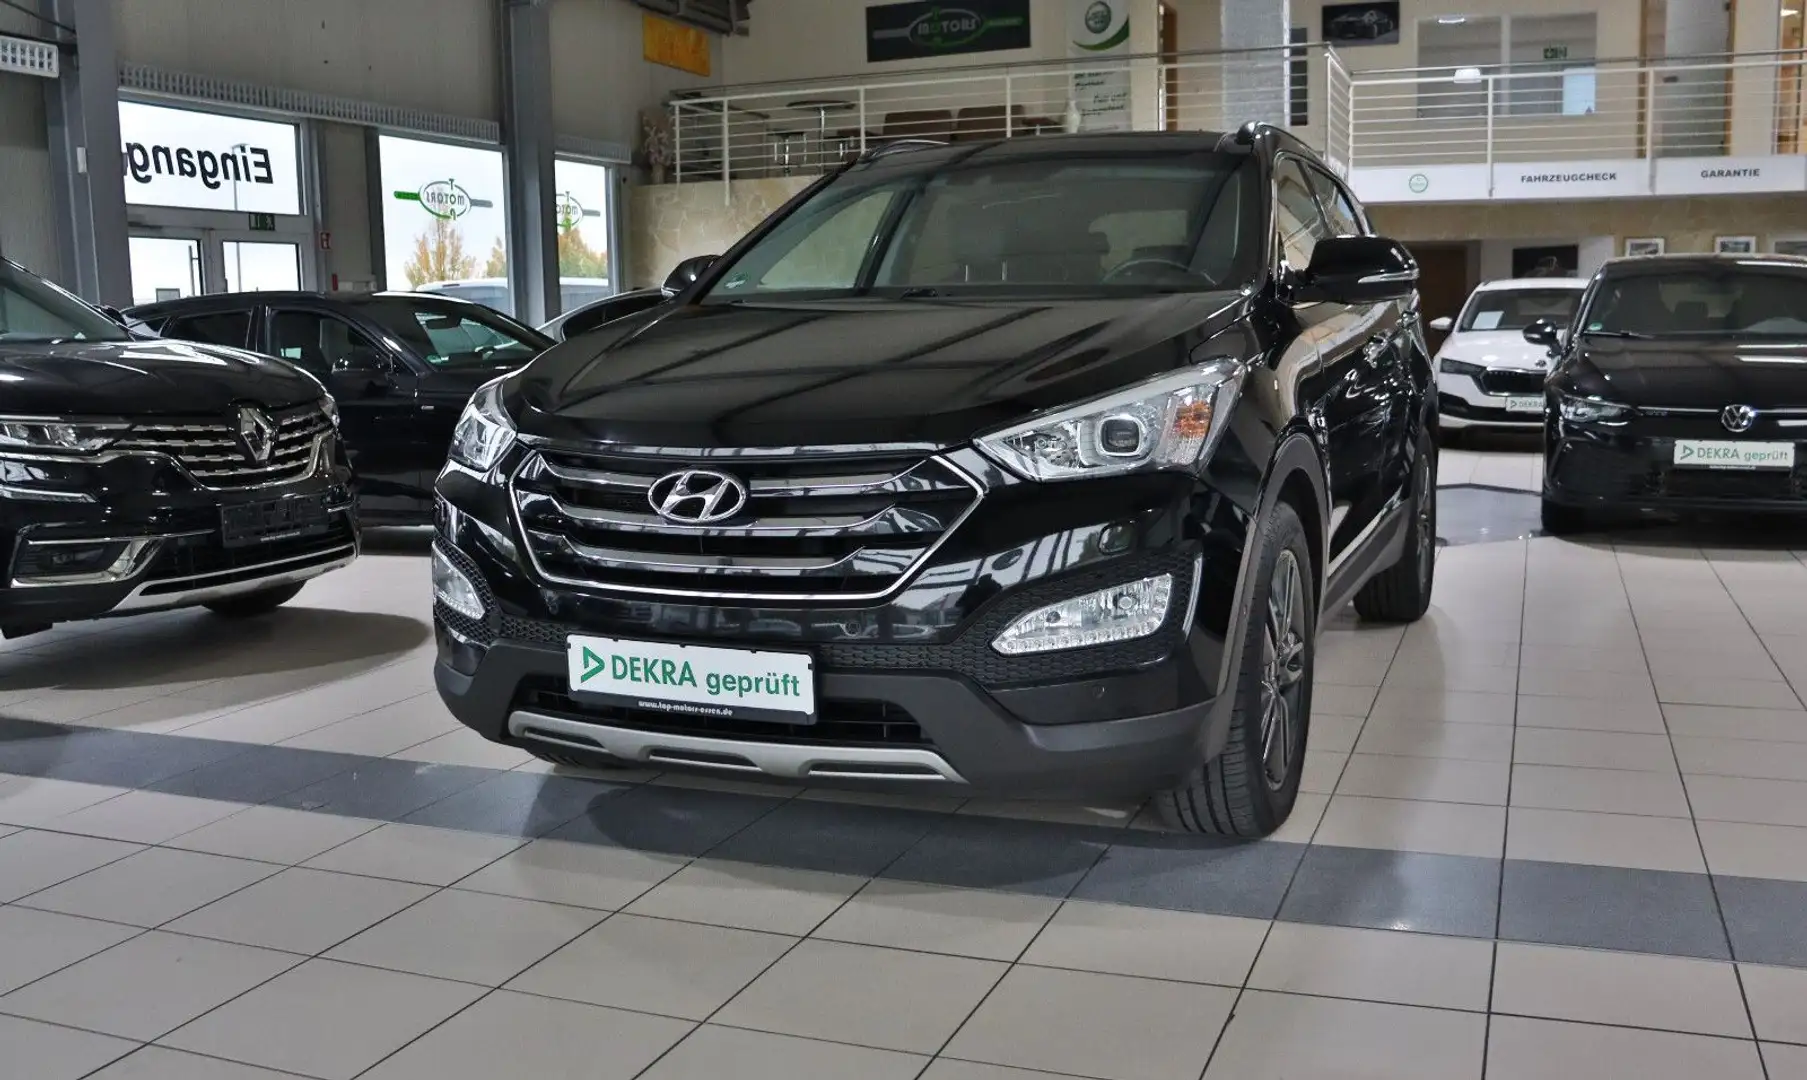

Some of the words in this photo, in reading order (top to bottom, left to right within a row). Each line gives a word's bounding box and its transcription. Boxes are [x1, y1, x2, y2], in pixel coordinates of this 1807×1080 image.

[1521, 172, 1617, 183] FAHRZEUGCHECK
[1700, 168, 1761, 179] GARANTIE
[1697, 447, 1740, 459] DEKRA
[1744, 451, 1788, 462] geprüft
[611, 654, 697, 687] DEKRA
[706, 671, 800, 697] geprüft
